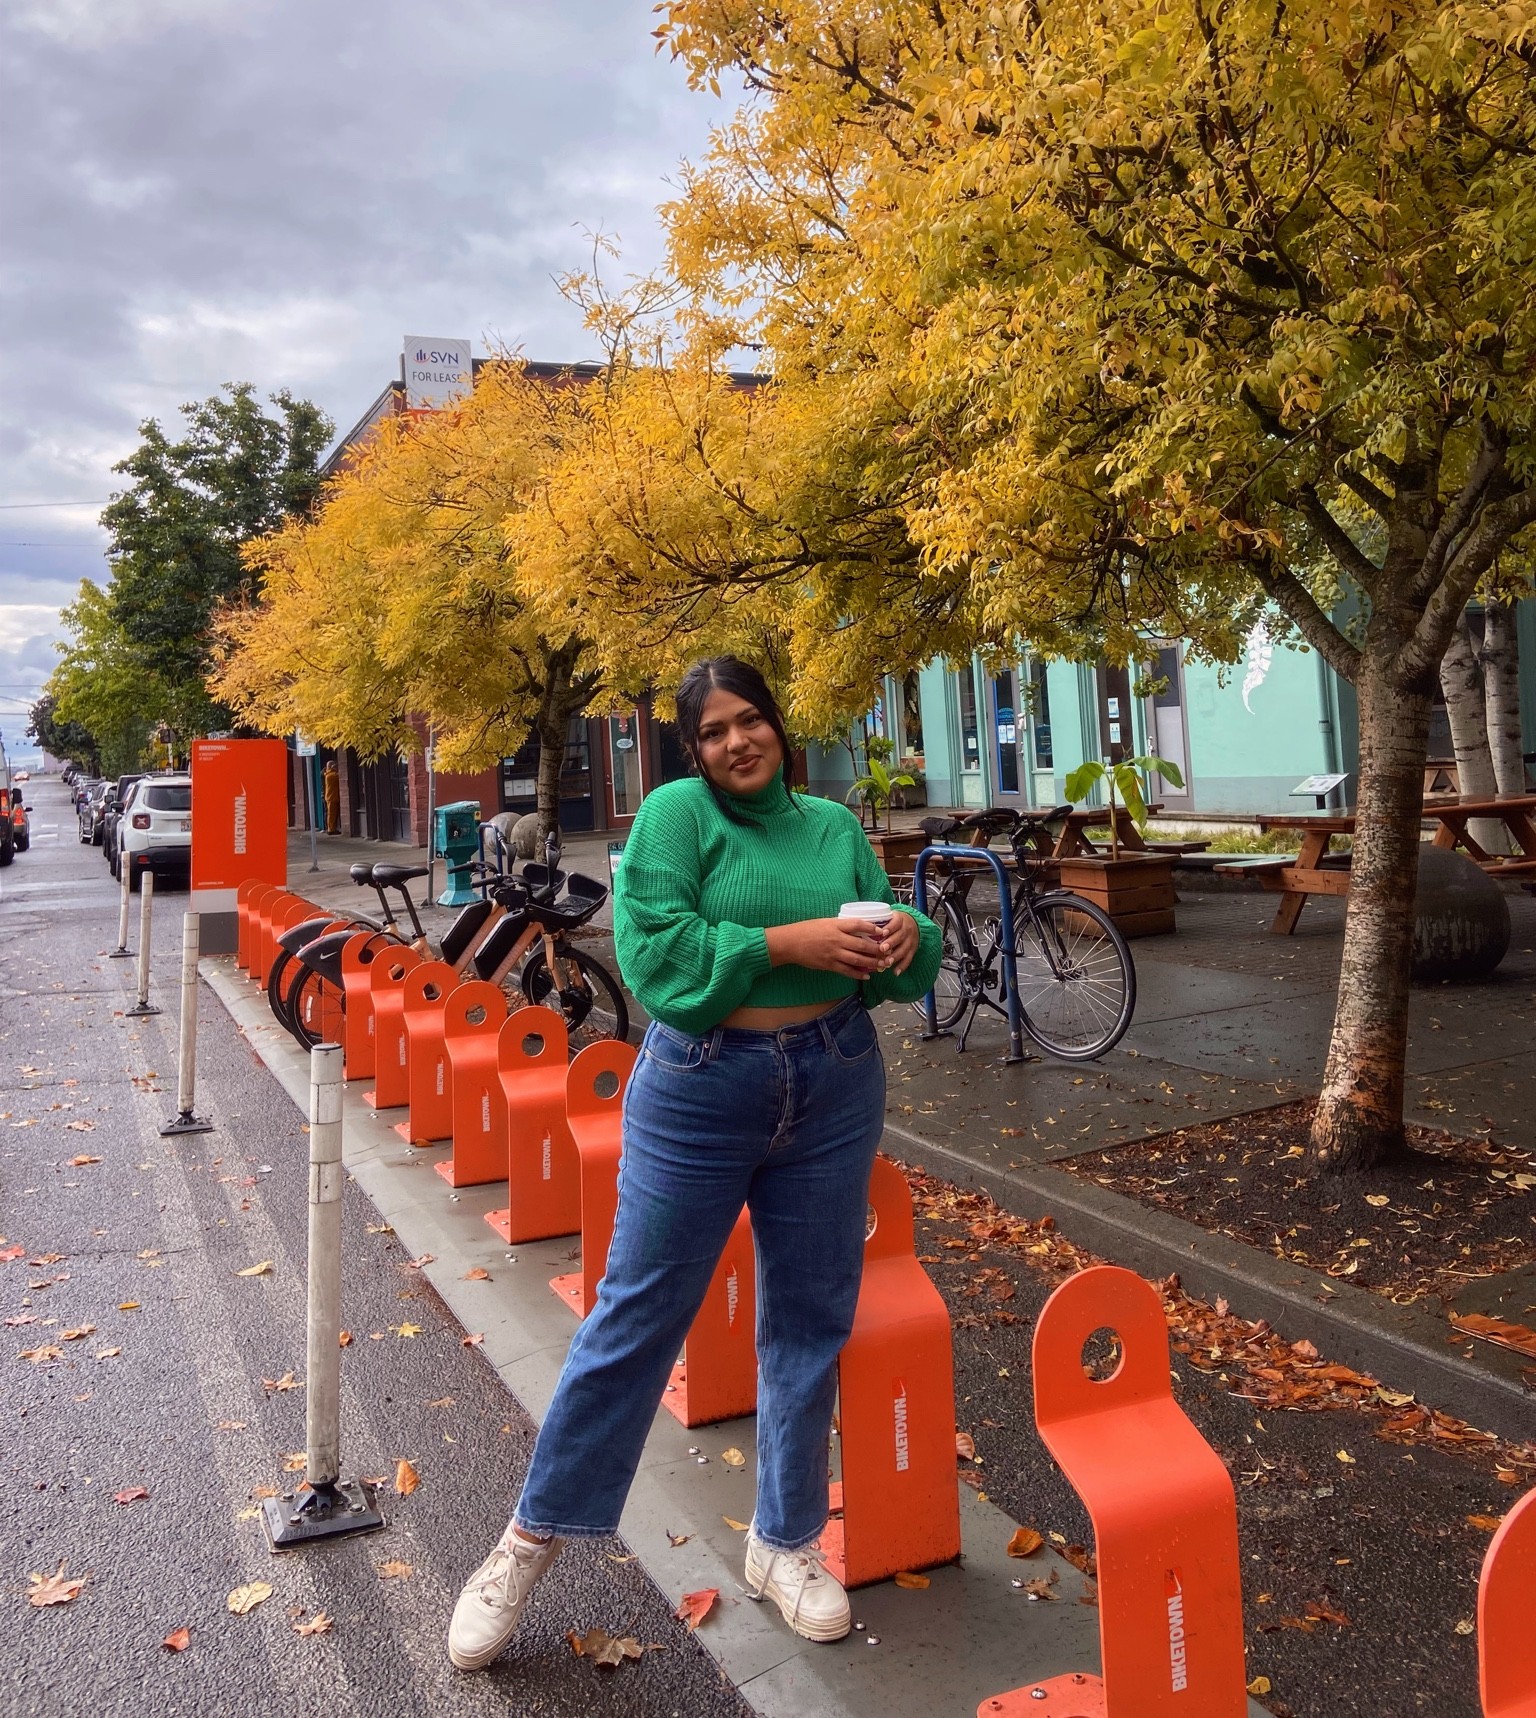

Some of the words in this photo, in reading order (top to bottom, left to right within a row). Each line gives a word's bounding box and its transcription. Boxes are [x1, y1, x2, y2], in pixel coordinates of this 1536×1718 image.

[412, 371, 432, 382] FOR
[430, 351, 458, 364] SVN
[234, 796, 247, 854] BIKETOWN
[482, 1096, 490, 1132] BIKETOWN
[542, 1138, 551, 1180] BIKETOWN
[894, 1397, 909, 1471] BIKETOWN
[1167, 1594, 1187, 1692] BIKETOWN
